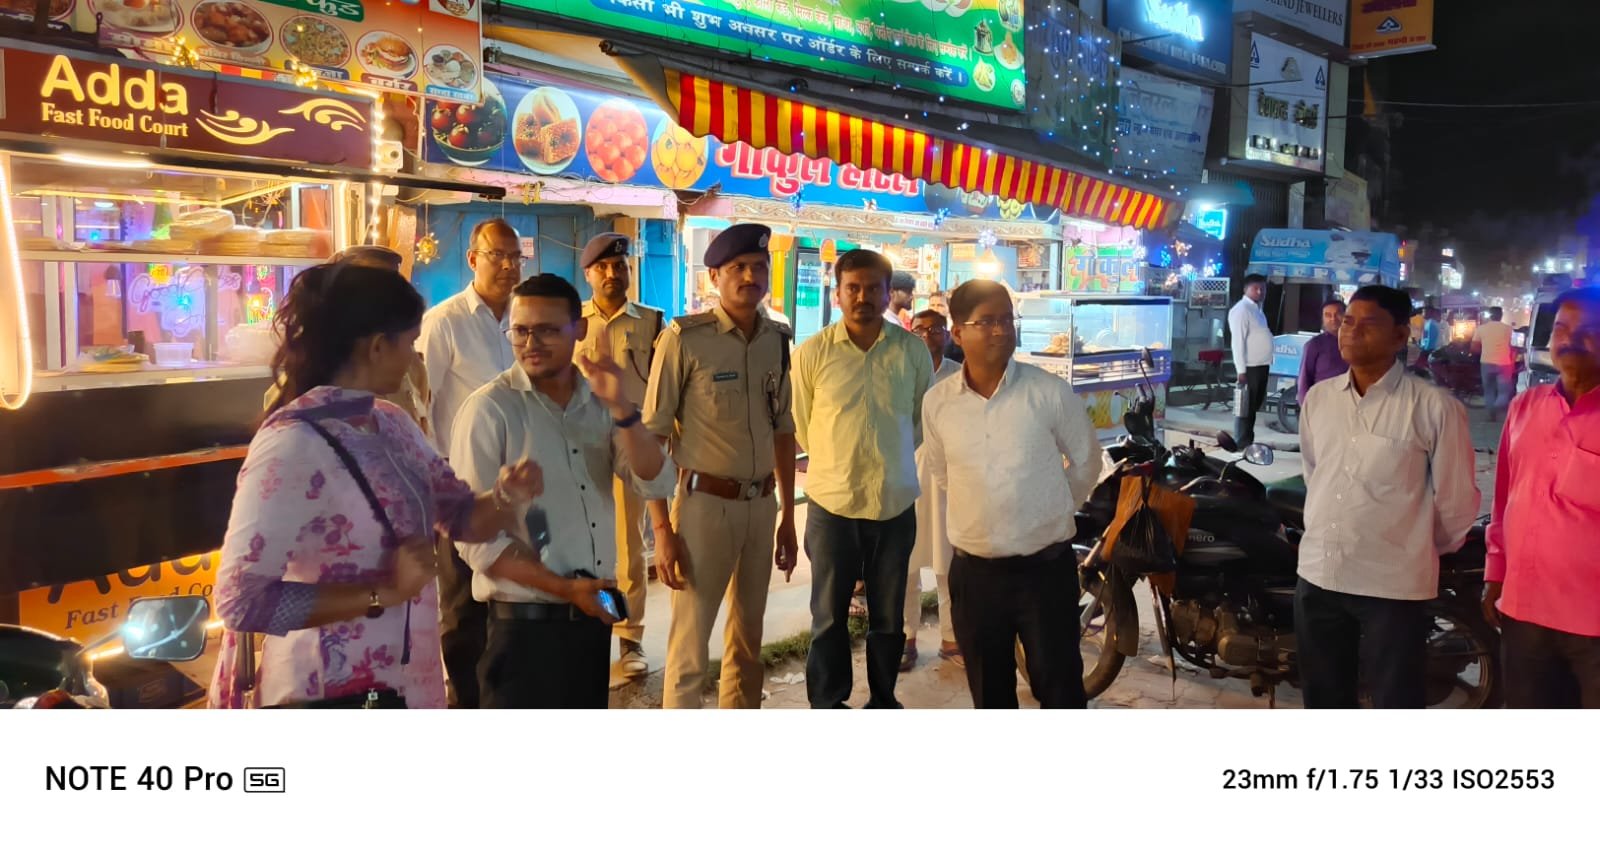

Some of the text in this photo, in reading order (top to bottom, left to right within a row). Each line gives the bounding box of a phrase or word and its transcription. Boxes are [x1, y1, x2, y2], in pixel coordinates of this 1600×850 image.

[1294, 0, 1343, 26] JEWELLERS
[662, 1, 686, 21] भी
[690, 10, 722, 29] शुभ
[729, 19, 777, 41] अवसर
[781, 31, 803, 47] पर
[809, 35, 845, 57] ऑर्डर
[849, 44, 862, 60] के
[867, 48, 893, 69] लिए
[897, 57, 931, 76] सम्पर्क
[935, 65, 953, 81] करें
[41, 54, 189, 115] Adda
[41, 102, 189, 137] Fast Food Court
[1260, 235, 1312, 248] Sudha
[66, 602, 119, 629] Fast
